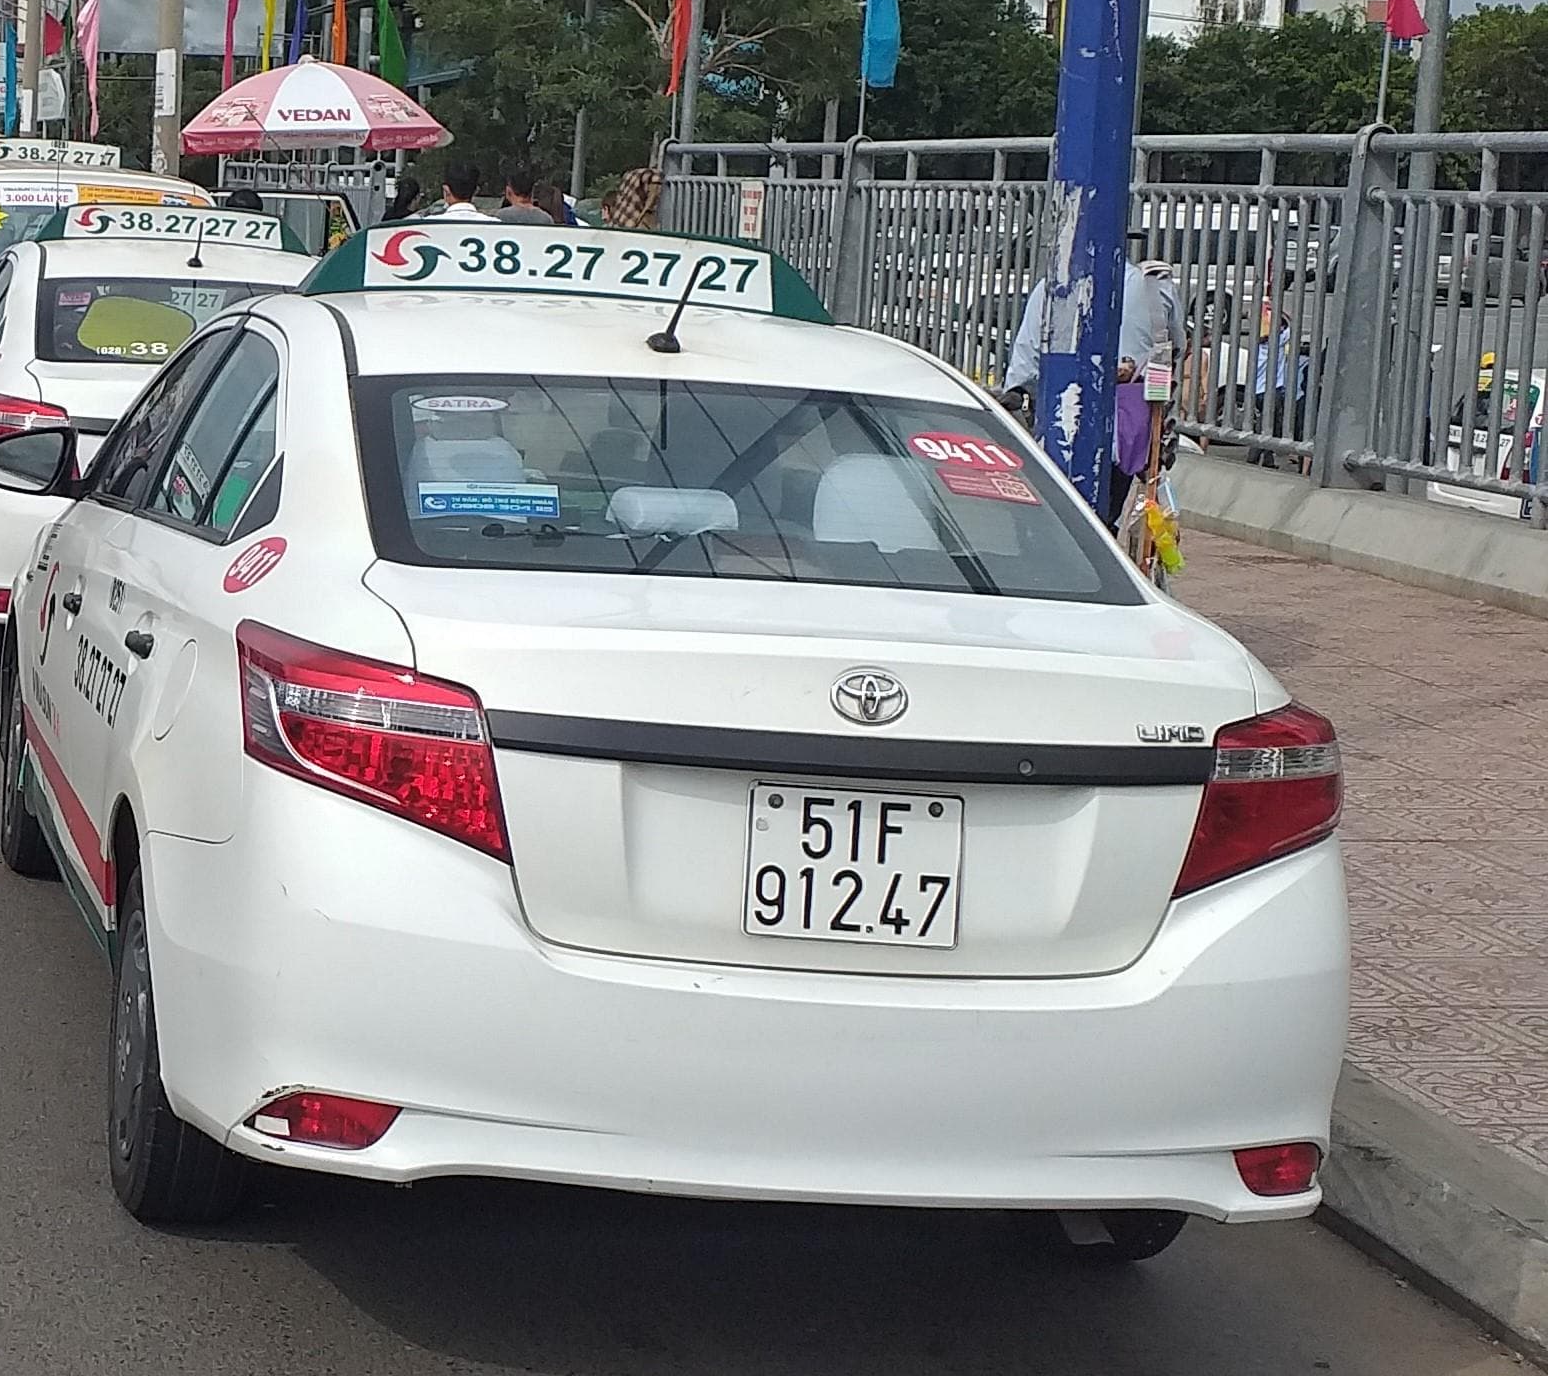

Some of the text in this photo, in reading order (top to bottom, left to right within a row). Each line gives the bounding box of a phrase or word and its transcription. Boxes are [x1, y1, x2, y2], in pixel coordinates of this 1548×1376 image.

[277, 109, 351, 122] VEDAN
[18, 146, 68, 160] 38.27
[73, 150, 95, 164] 27
[5, 194, 34, 202] 3.000
[120, 211, 278, 241] 38.27 27 27
[457, 233, 760, 295] 38.27 27 27
[197, 293, 220, 308] 27
[96, 342, 169, 356] (028) 38
[426, 397, 493, 410] SATRA
[913, 437, 1018, 468] 9411
[229, 543, 284, 588] 9411
[74, 633, 102, 706] 38.27
[95, 655, 113, 717] 27
[107, 667, 127, 729] 27
[1137, 723, 1205, 743] LIMO
[802, 798, 912, 865] 51F
[754, 864, 951, 938] 912.47
